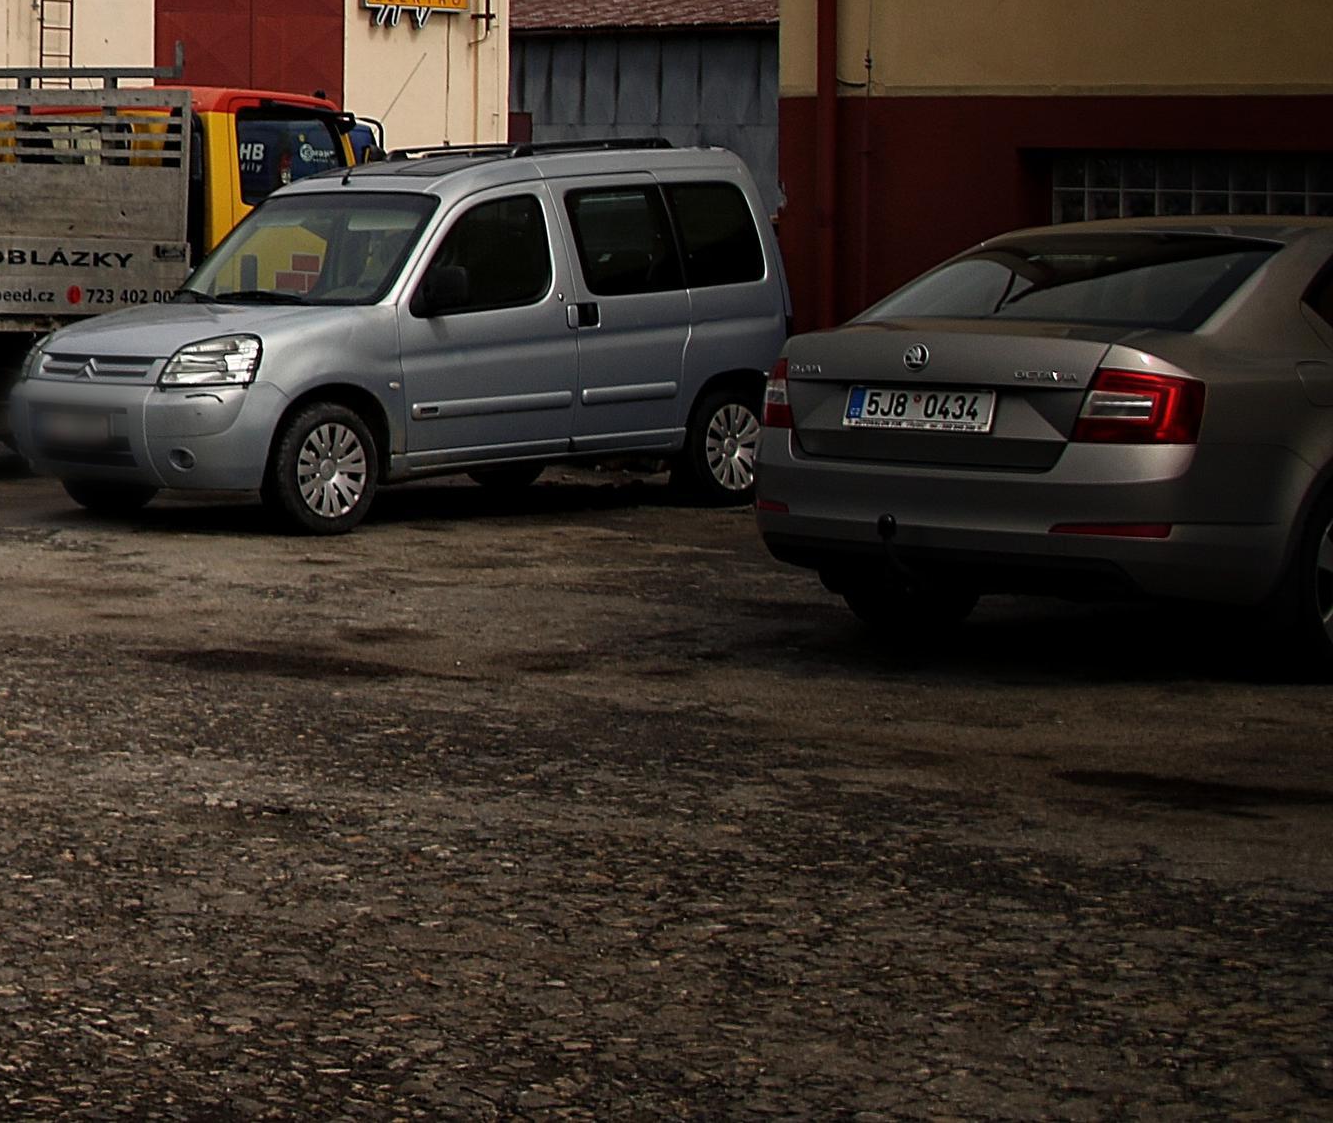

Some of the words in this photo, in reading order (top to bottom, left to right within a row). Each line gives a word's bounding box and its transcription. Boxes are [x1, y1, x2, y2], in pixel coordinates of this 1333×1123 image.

[86, 288, 115, 304] 723
[120, 288, 147, 304] 402
[153, 289, 180, 304] 00
[866, 391, 908, 417] 5J8
[923, 393, 978, 421] 0434
